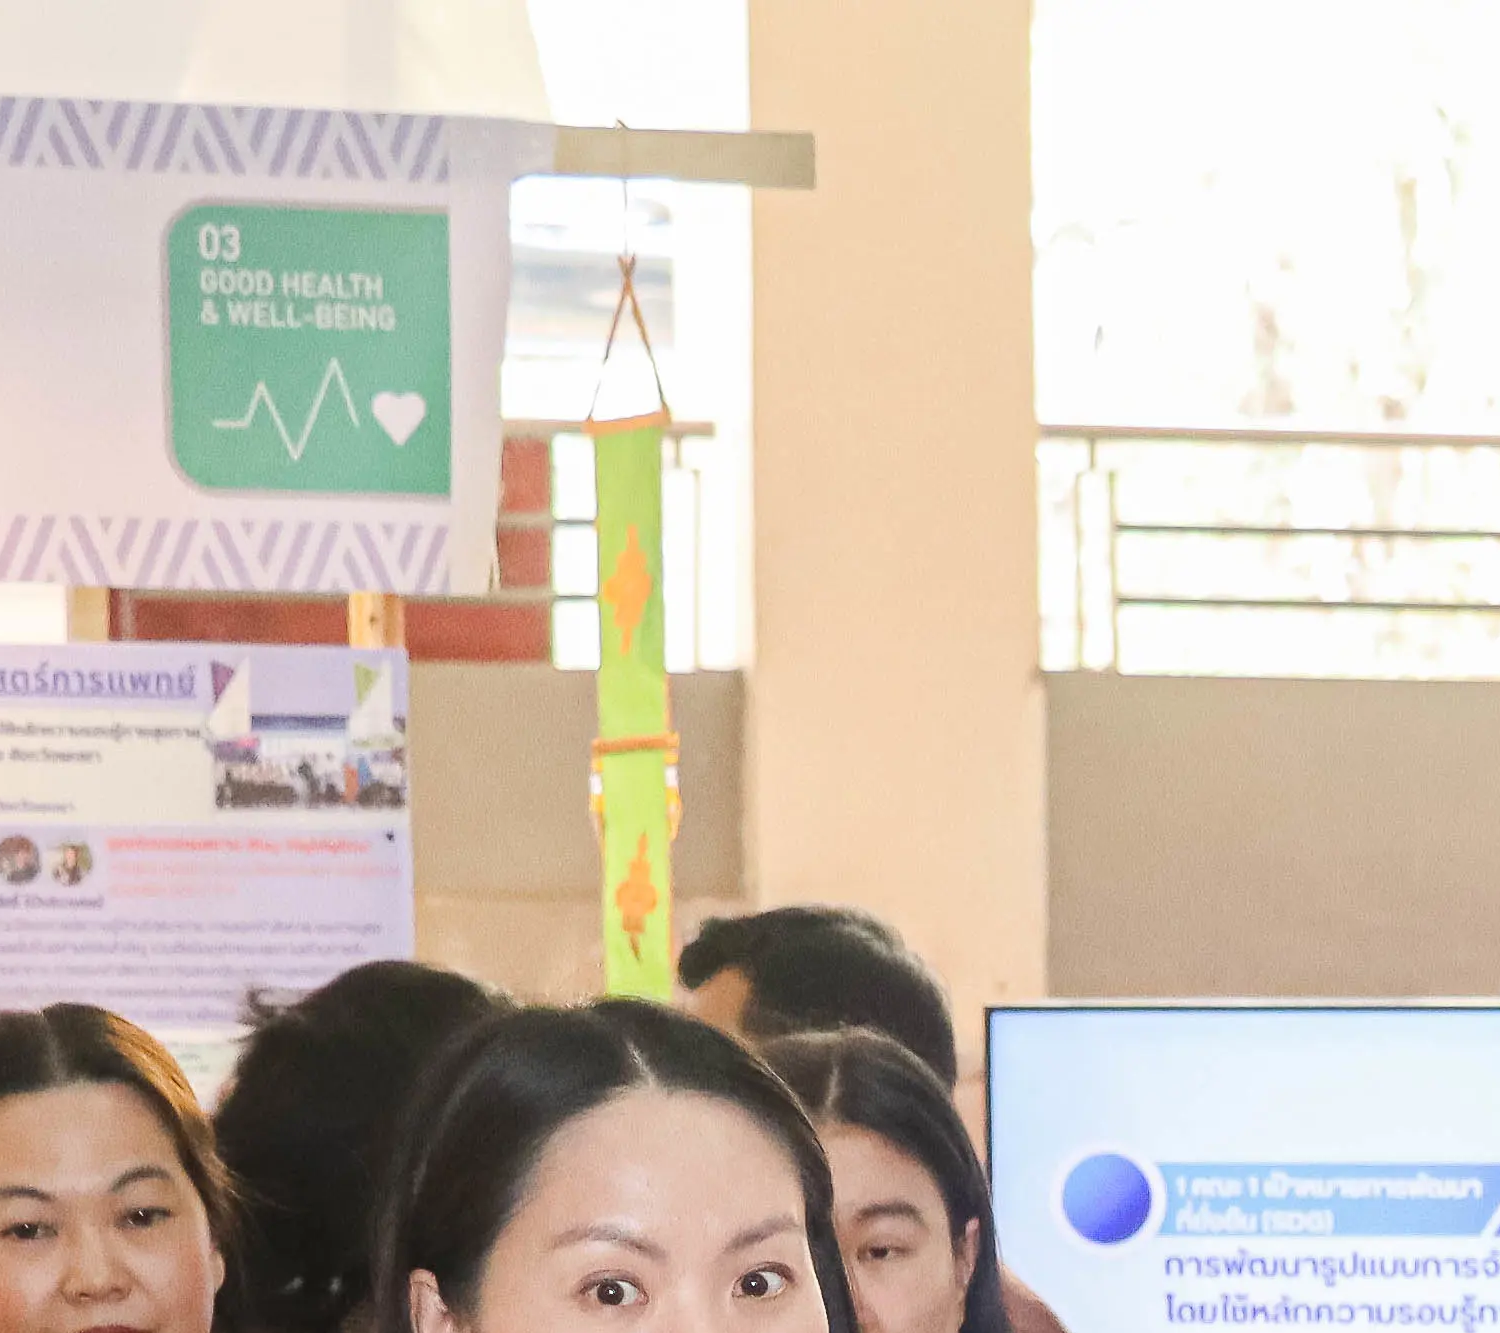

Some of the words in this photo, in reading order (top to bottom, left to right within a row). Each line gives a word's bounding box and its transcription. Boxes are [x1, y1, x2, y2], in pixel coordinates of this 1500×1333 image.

[198, 222, 242, 262] 03
[200, 267, 274, 297] GOOD
[282, 272, 384, 301] HEALTH
[200, 299, 219, 325] &
[226, 299, 397, 332] WELL-BEING
